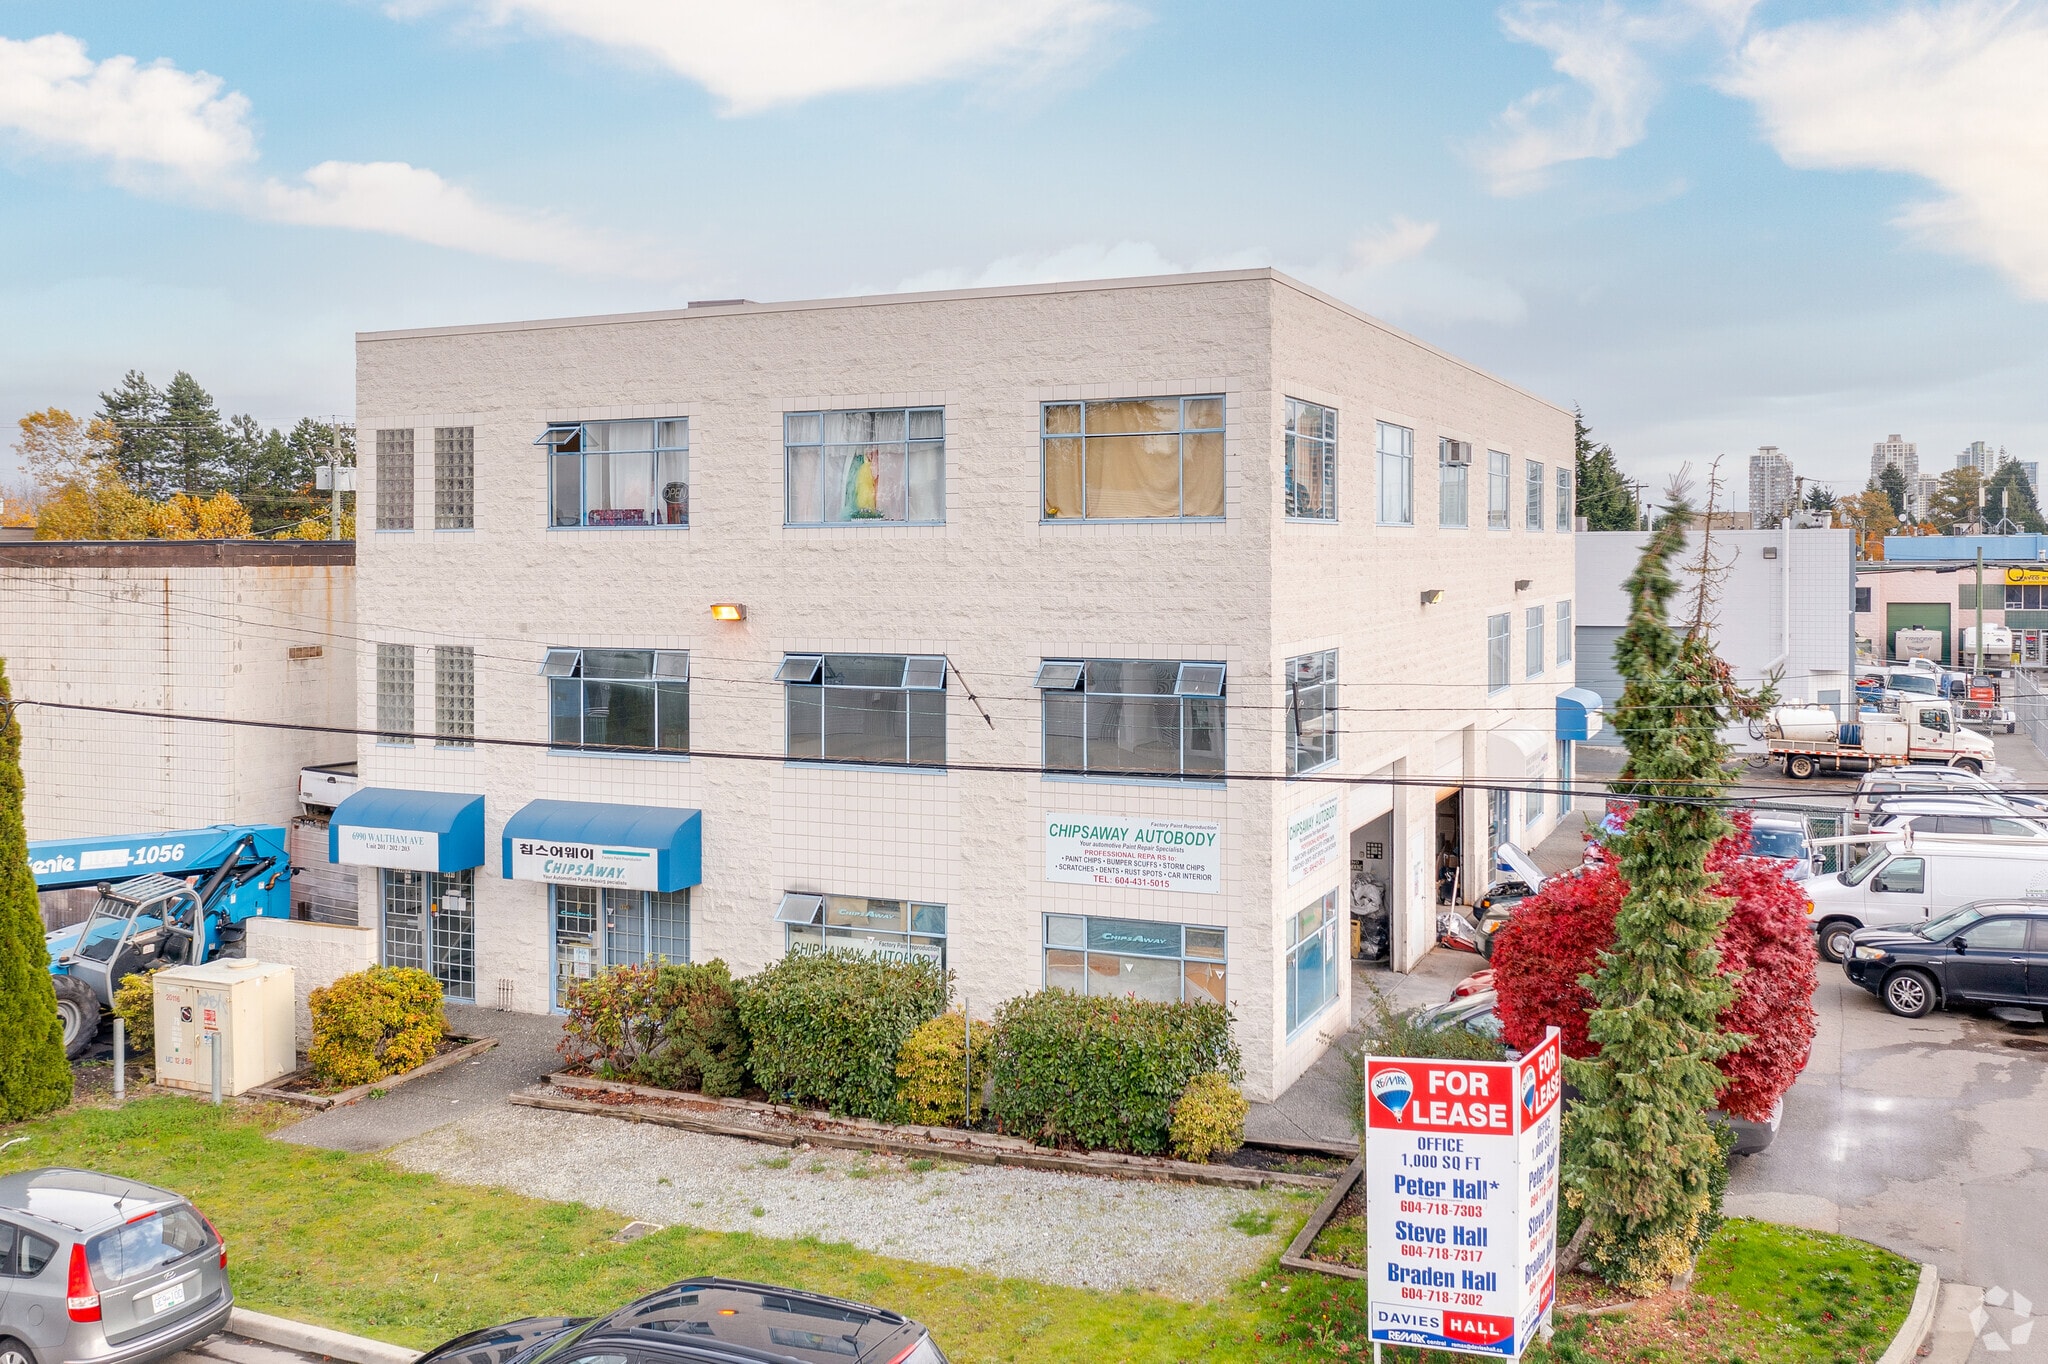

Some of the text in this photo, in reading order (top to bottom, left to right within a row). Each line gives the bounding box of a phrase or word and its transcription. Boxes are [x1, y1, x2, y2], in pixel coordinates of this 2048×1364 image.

[664, 487, 686, 499] OPEN
[1049, 823, 1216, 847] CHIPSAWAY AUTOBODY
[1150, 821, 1217, 831] Factory Paint Reproduction
[351, 832, 425, 846] 6990 WALTHAM AVE
[1092, 841, 1121, 849] automotive
[1137, 844, 1155, 852] Repair
[1155, 845, 1185, 853] Specialists
[519, 843, 594, 861] 칩스어웨이
[1084, 849, 1136, 859] PROFESSIONAL
[1058, 863, 1212, 881] SCRATCHES DENTS RUST SPOTS CAR INTERIOR
[1065, 855, 1205, 872] PAINT CHIPS BUMPER SCUFFS STORM CHIPS
[1093, 874, 1170, 888] TEL: 604-431-5015
[878, 941, 897, 949] Factory
[910, 944, 940, 952] eproduction
[1538, 1044, 1556, 1080] FOR
[1375, 1074, 1408, 1090] RE/MAX
[1428, 1070, 1490, 1097] FOR
[1535, 1069, 1560, 1115] LEASE
[1412, 1100, 1508, 1129] LEASE
[1417, 1136, 1464, 1153] OFFICE
[1401, 1153, 1482, 1172] 1,000 SQ FT
[1394, 1174, 1446, 1197] Peter
[1400, 1200, 1483, 1218] 604-718-7303
[1528, 1208, 1545, 1239] Steve
[1395, 1220, 1488, 1248] Steve Hall
[1401, 1244, 1483, 1263] 604-718-7317
[1387, 1261, 1497, 1292] Braden Hall
[1401, 1286, 1483, 1307] 604-718-7302
[1378, 1311, 1500, 1336] DAVIES HALL
[1388, 1330, 1428, 1345] RE/MAX
